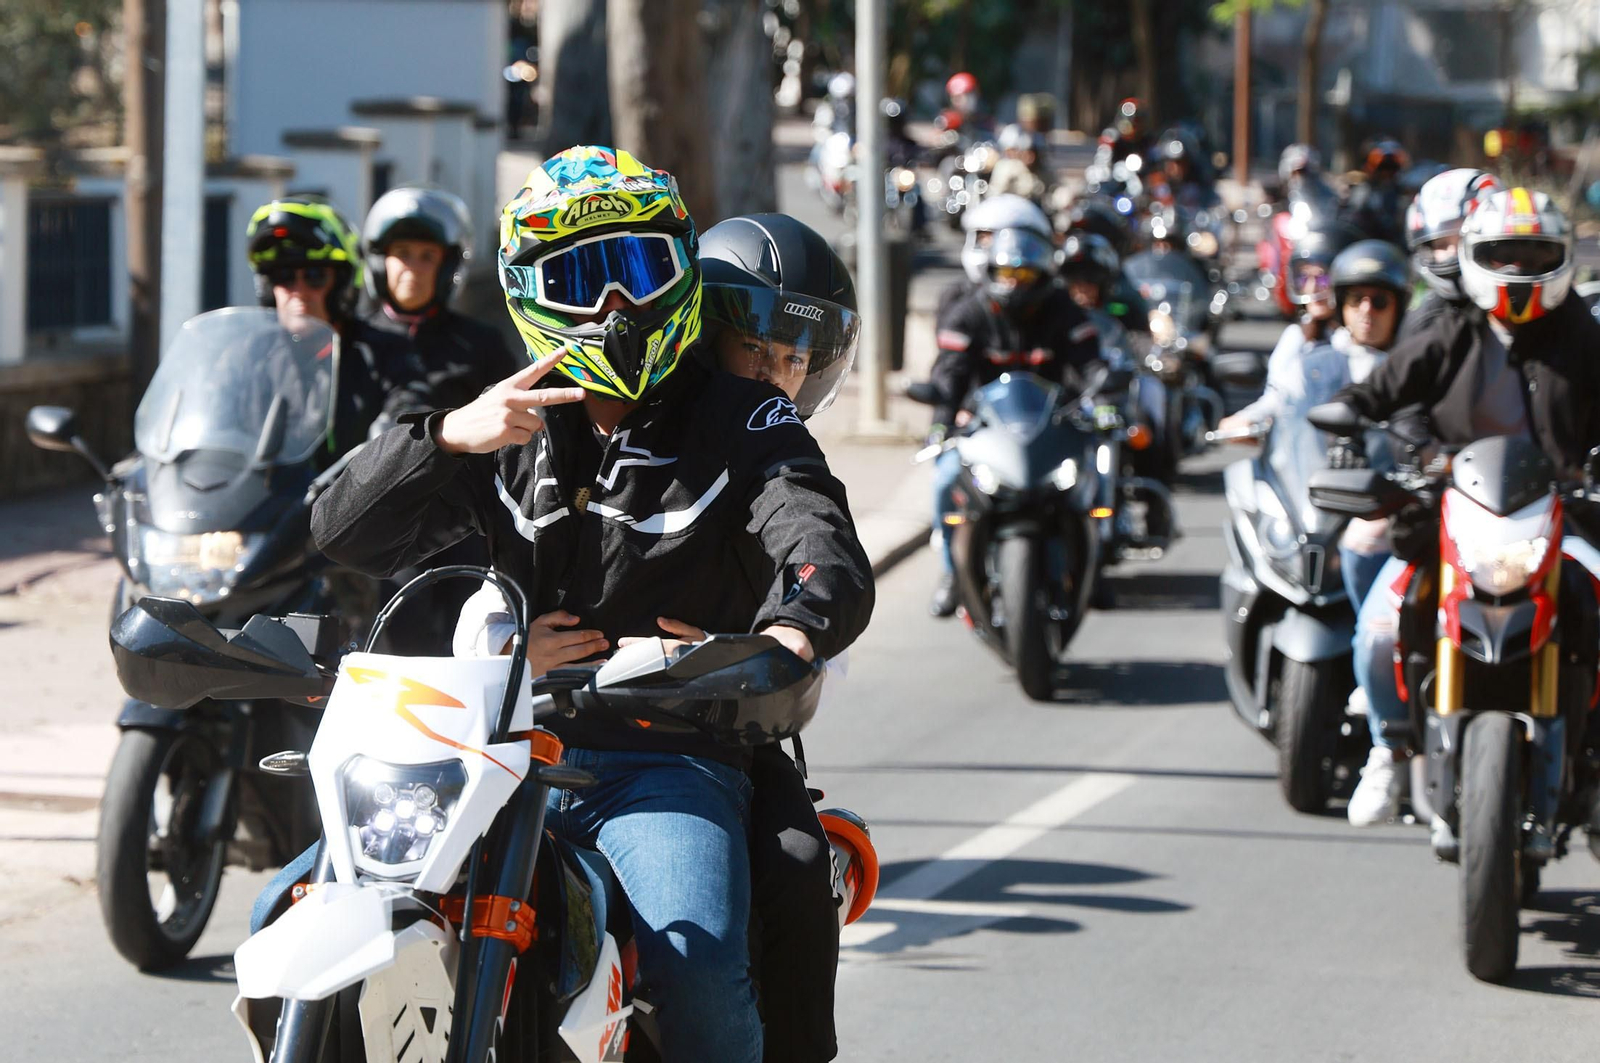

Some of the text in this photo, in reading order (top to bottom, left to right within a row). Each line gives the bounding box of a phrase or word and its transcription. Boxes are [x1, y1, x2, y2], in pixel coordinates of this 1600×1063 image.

[564, 195, 630, 225] Airoh
[584, 213, 611, 222] HELMET
[590, 354, 618, 380] Airoh
